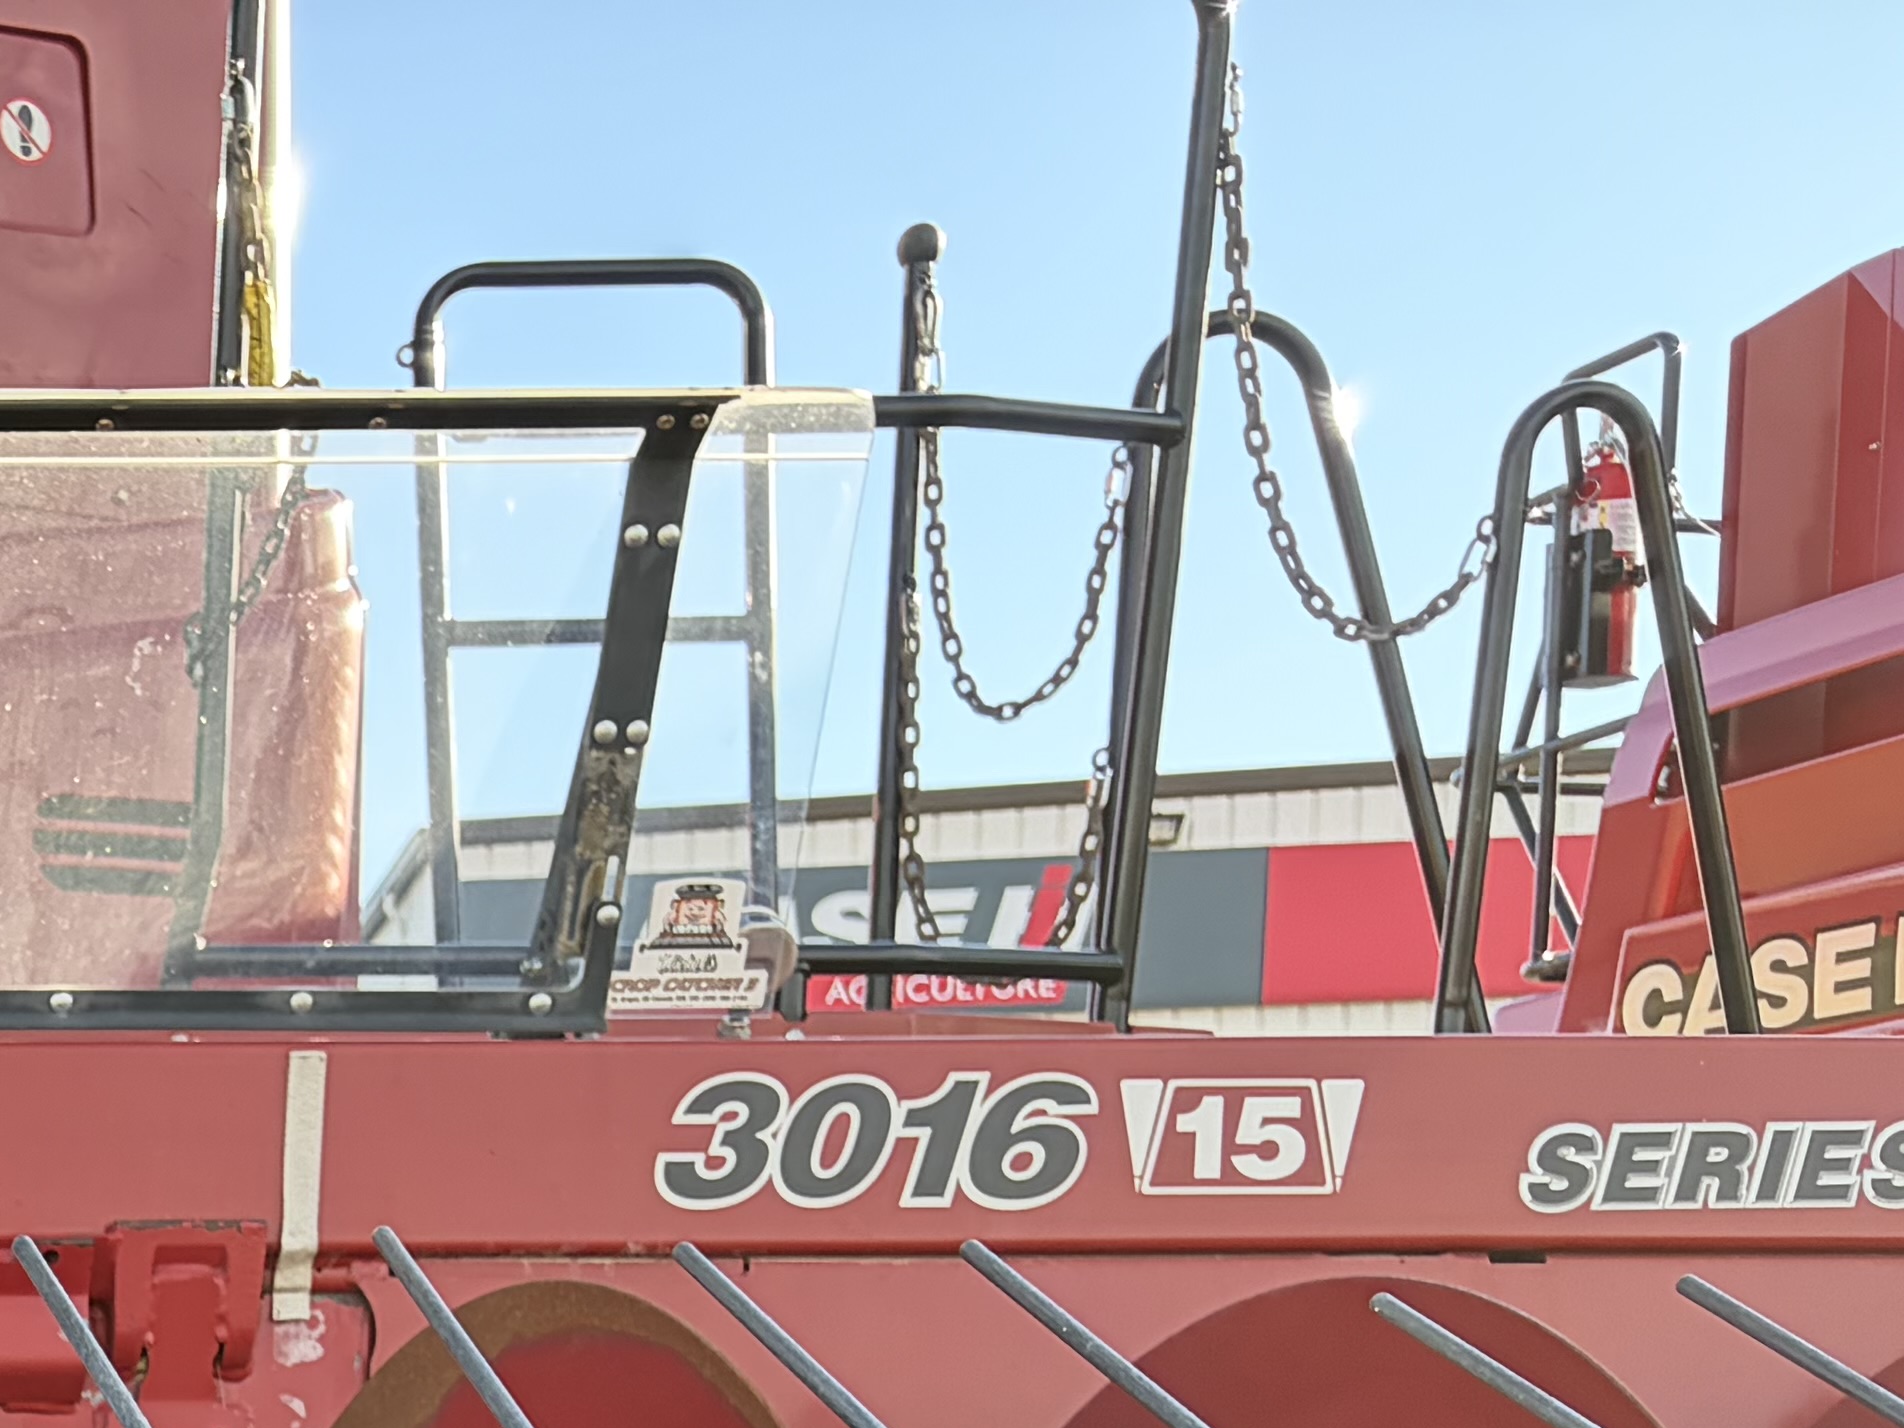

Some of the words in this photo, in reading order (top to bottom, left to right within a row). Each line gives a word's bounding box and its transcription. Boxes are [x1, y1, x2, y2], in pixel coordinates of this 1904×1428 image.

[824, 973, 1058, 1006] AGICULURE
[654, 1071, 1099, 1211] 3016
[1175, 1094, 1308, 1181] 15
